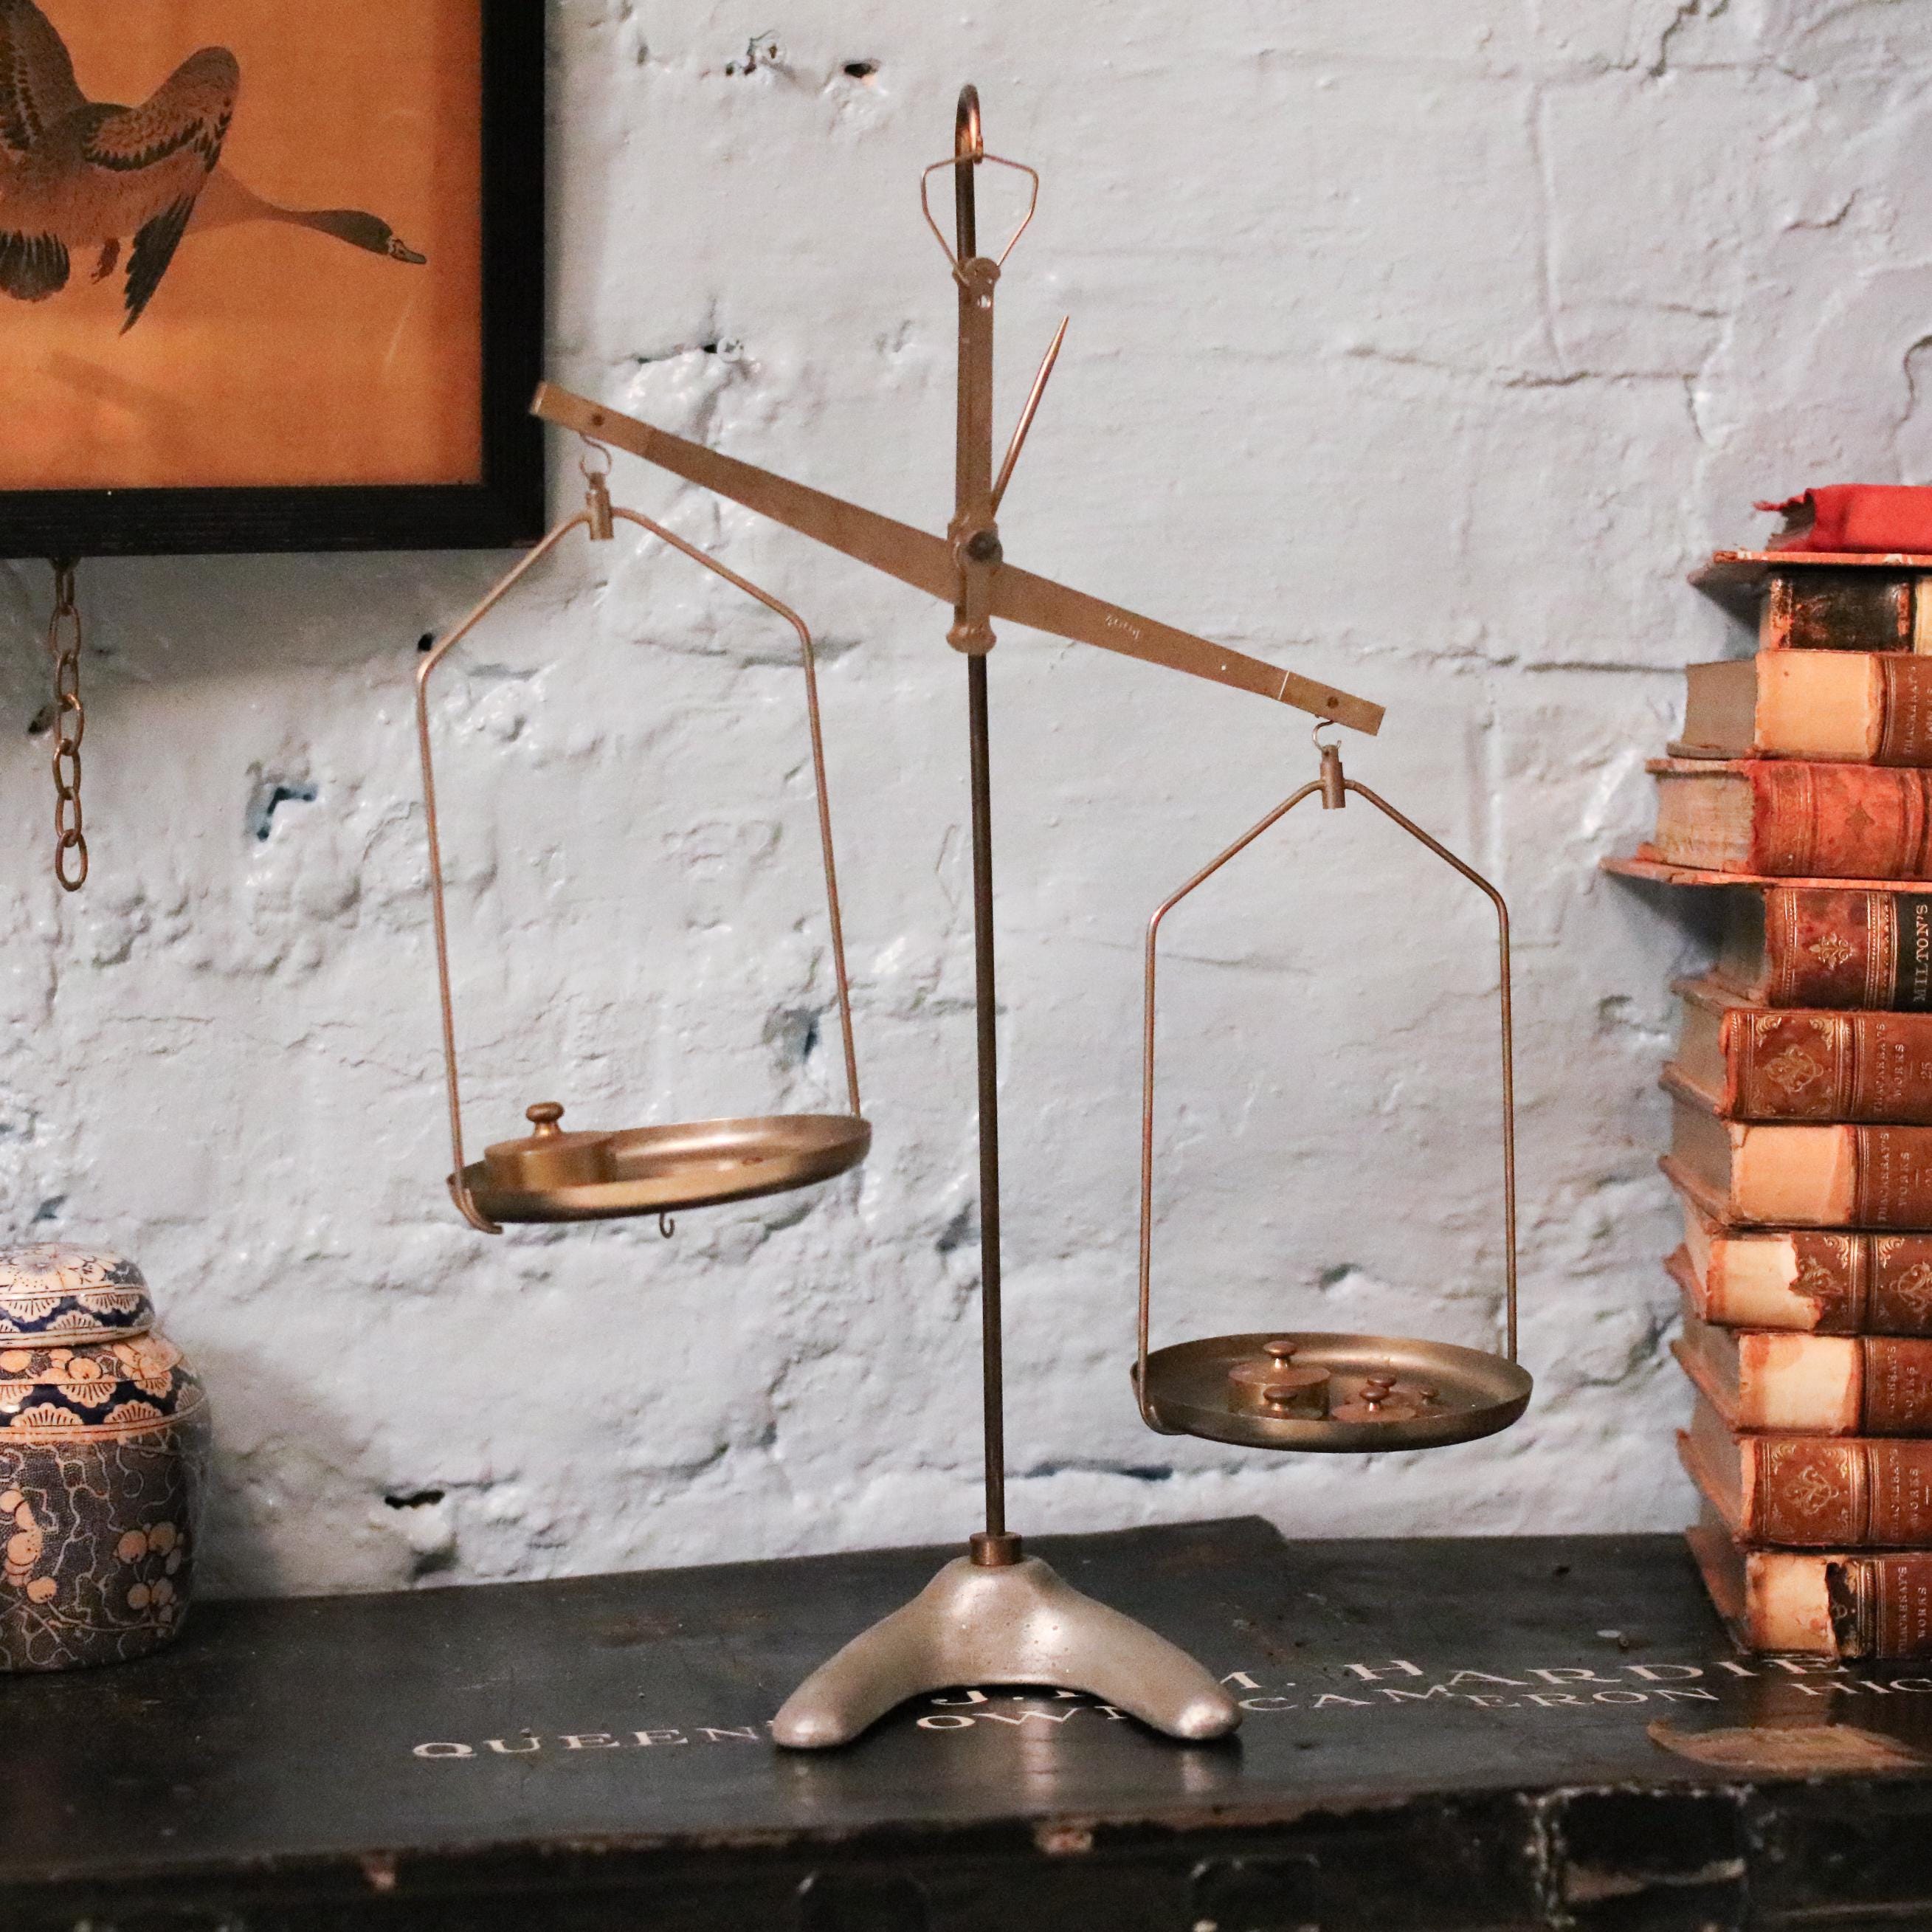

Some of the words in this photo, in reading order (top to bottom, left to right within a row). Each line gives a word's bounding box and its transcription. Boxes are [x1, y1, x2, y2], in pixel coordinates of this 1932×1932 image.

[1913, 904, 1929, 1002] MILTON'S
[1343, 1660, 1850, 1687] HARDIE
[1238, 1684, 1719, 1711] CAMERON
